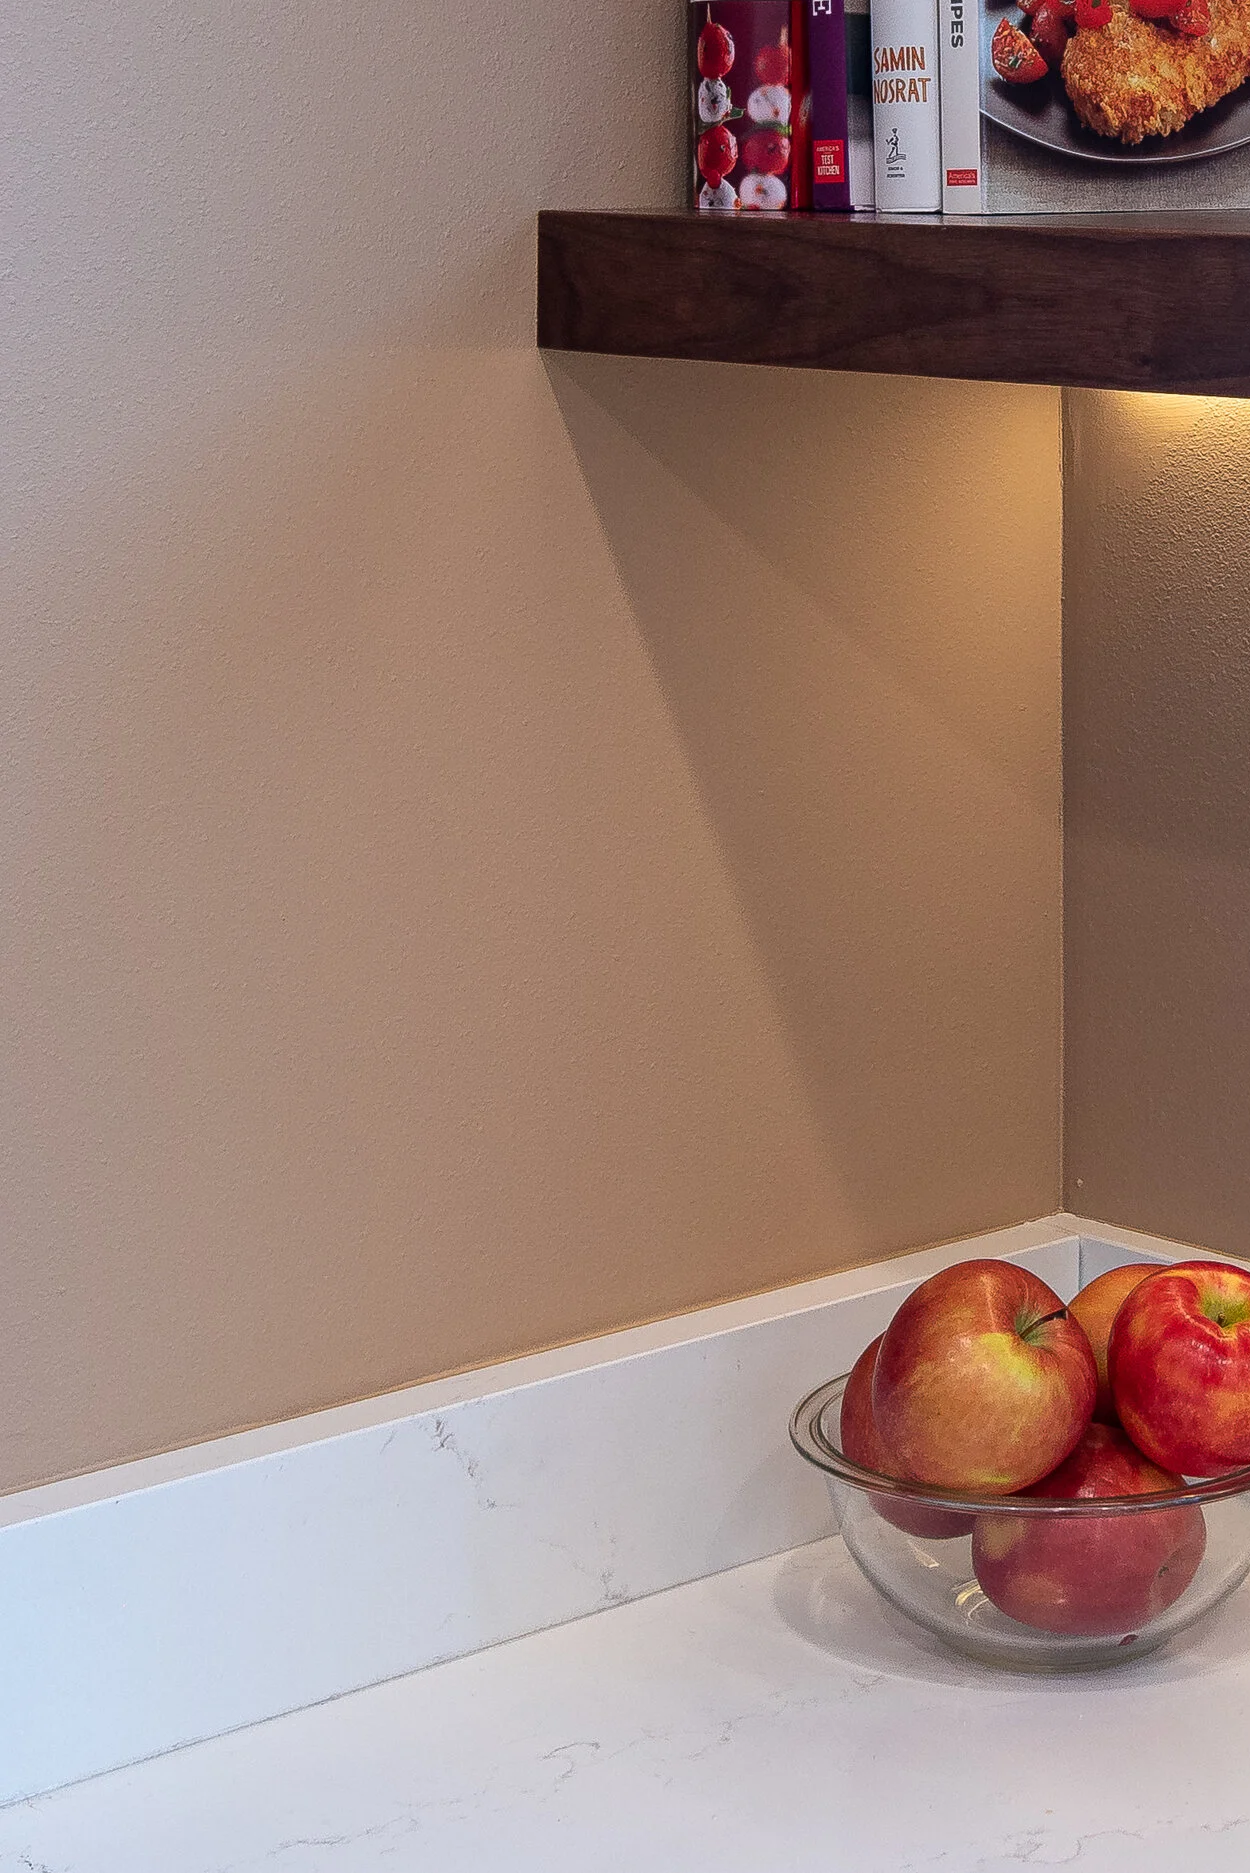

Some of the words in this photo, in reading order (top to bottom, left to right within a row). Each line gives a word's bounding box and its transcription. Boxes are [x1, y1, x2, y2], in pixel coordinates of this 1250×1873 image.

[873, 46, 925, 74] SAMIN
[873, 77, 931, 105] NOSRAT
[821, 154, 834, 165] TEST
